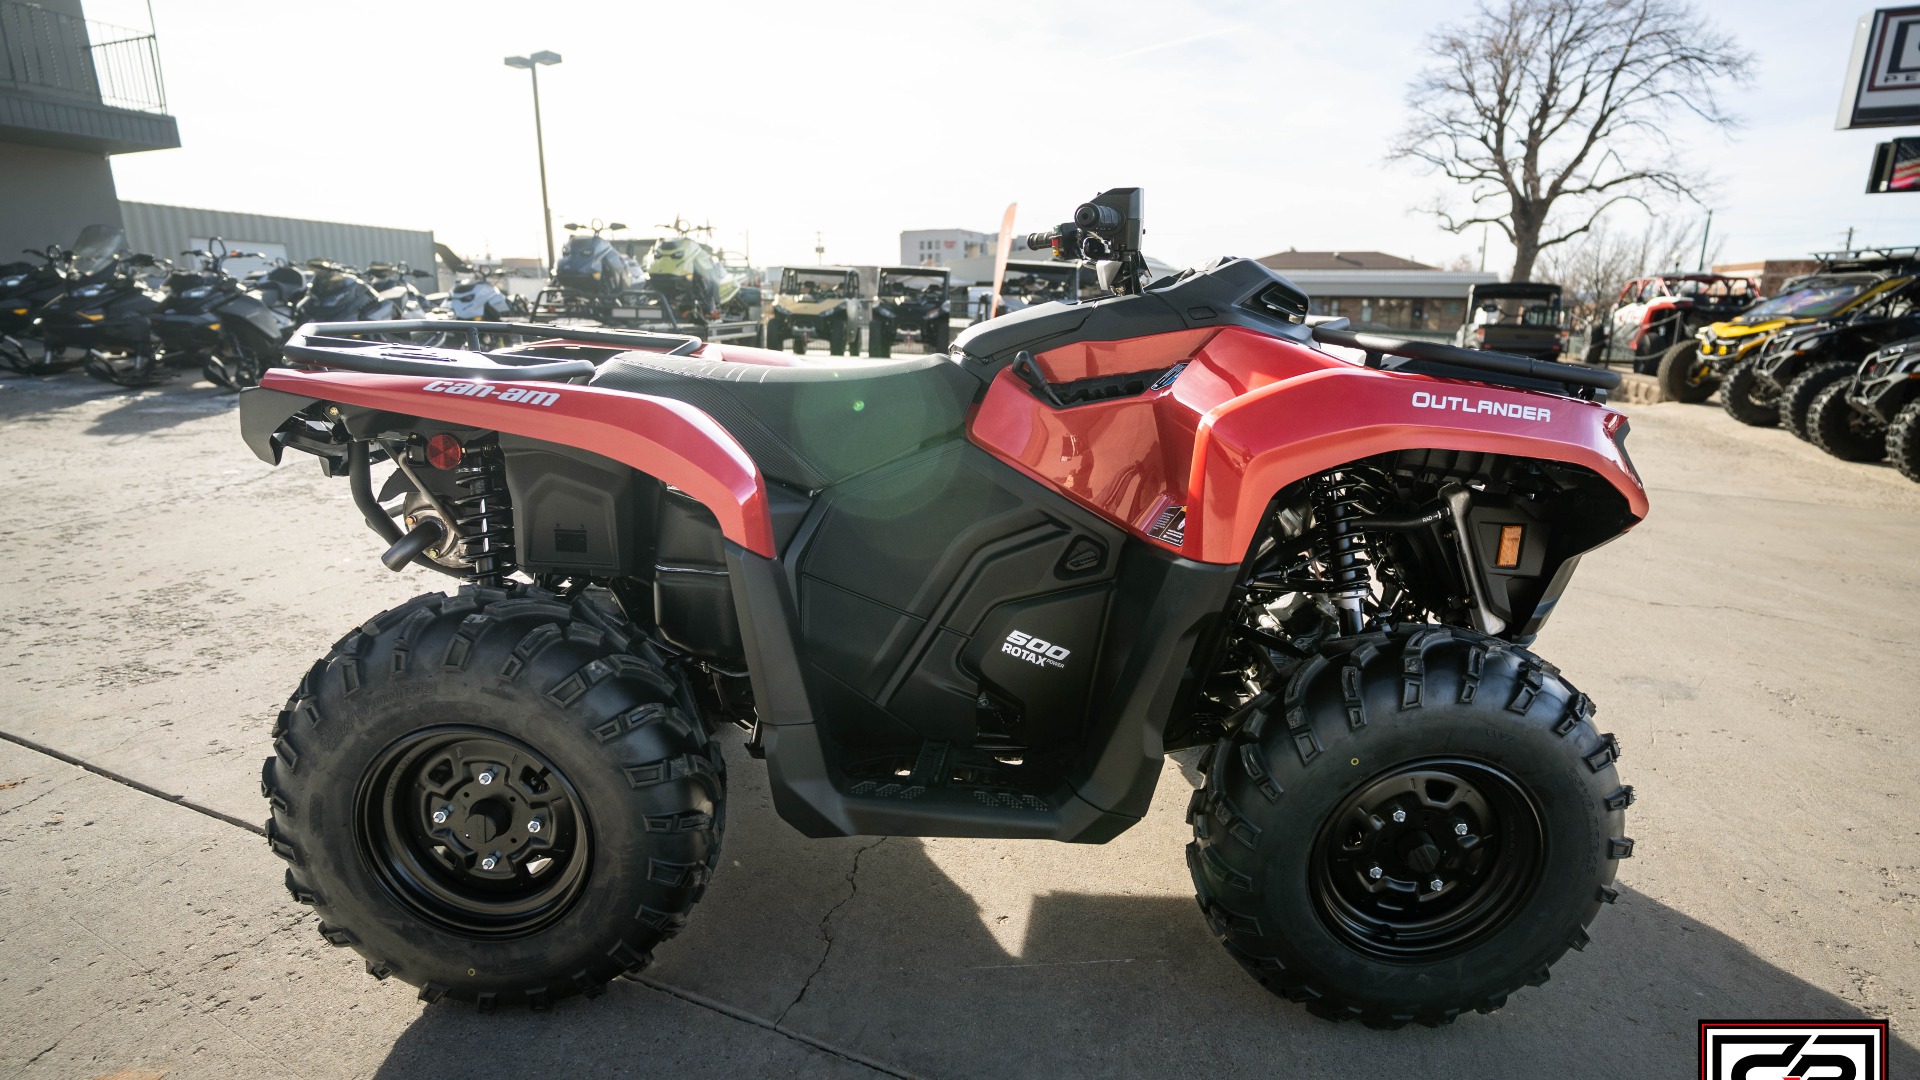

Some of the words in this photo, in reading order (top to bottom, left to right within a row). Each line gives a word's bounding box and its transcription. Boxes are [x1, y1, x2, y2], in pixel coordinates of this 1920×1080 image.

[1411, 391, 1551, 423] OUTLANDER
[1001, 642, 1047, 668] ROTAX
[1045, 658, 1065, 669] POWER
[1006, 629, 1071, 661] 500
